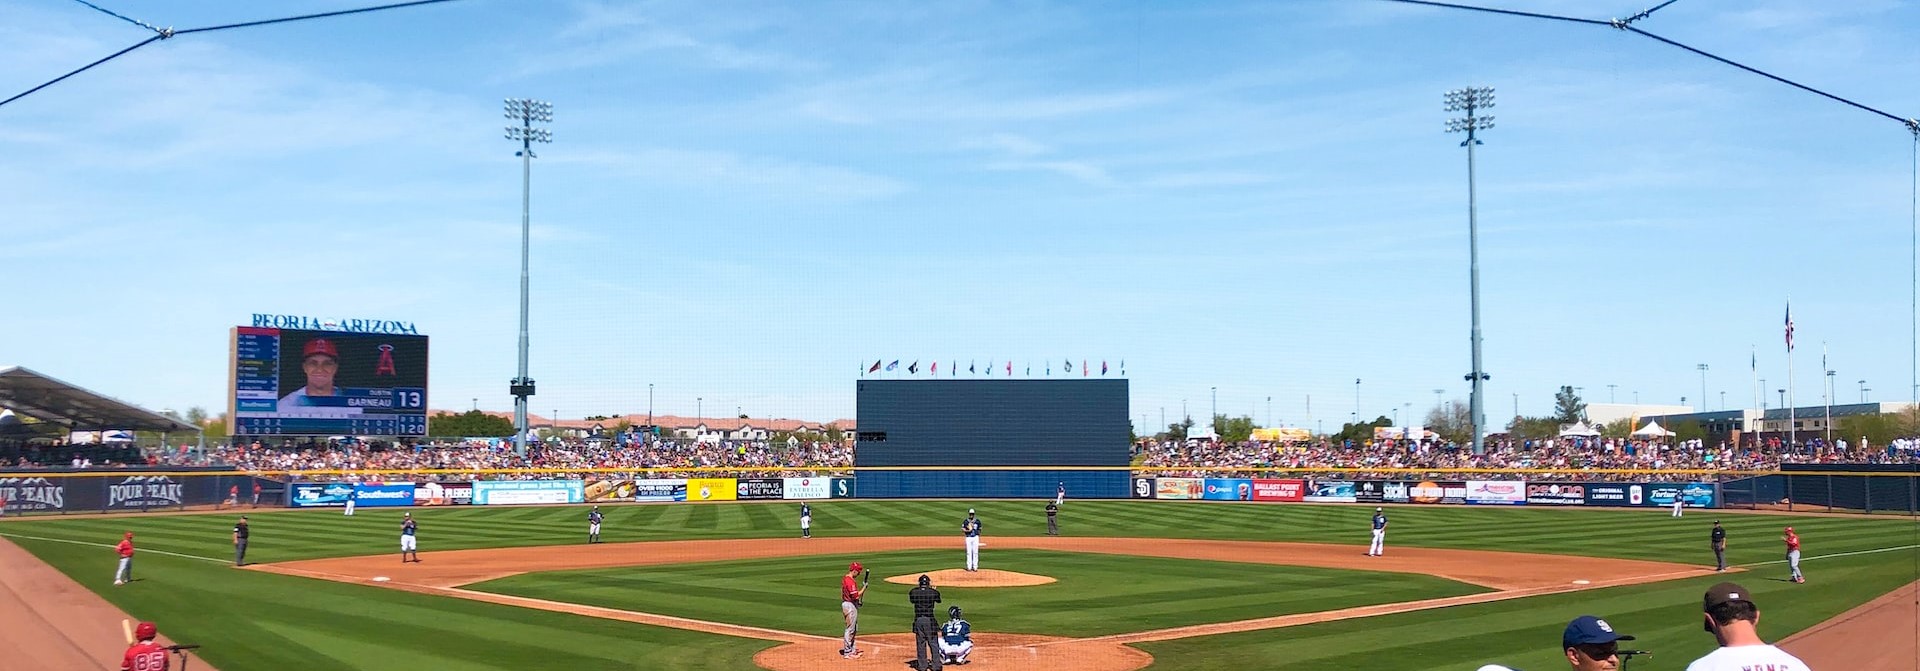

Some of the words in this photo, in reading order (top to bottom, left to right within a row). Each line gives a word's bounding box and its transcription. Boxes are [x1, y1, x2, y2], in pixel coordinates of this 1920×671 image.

[252, 313, 321, 329] PEORIA
[337, 318, 417, 334] ARIZONA
[347, 398, 392, 406] GARNEAU
[398, 391, 421, 407] 13
[401, 424, 406, 434] 1
[408, 424, 416, 434] 2
[417, 424, 425, 434] 0
[108, 485, 143, 506] FOUR
[357, 490, 404, 499] Southwest
[135, 652, 164, 671] 85
